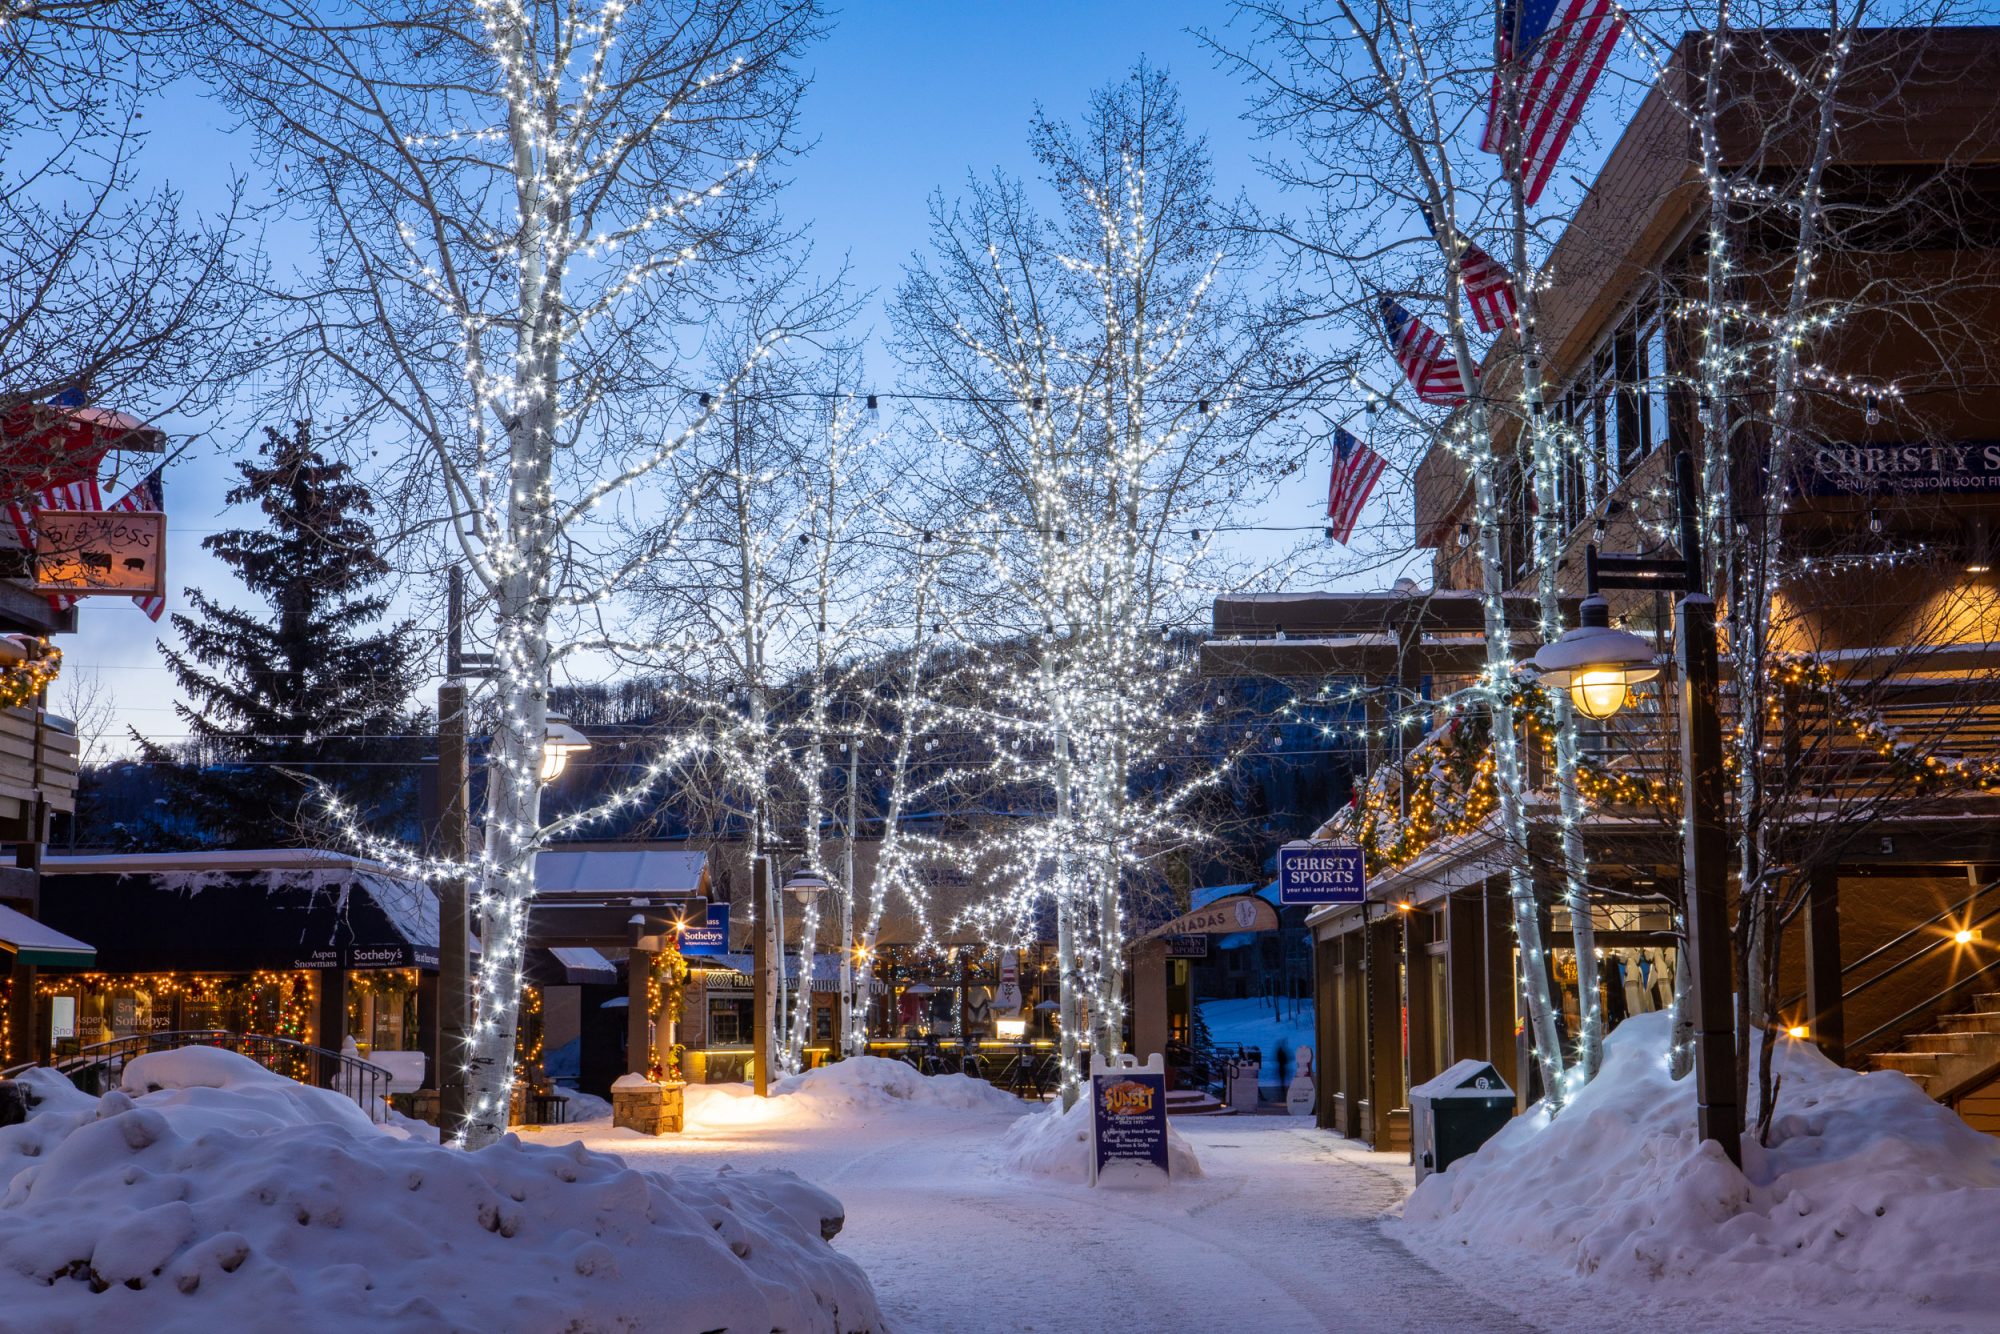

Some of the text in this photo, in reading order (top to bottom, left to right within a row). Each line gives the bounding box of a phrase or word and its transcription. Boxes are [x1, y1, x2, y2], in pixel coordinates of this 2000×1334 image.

[1814, 446, 1973, 473] CHRISTY
[1902, 476, 1950, 488] CUSTOM
[1953, 476, 1985, 487] BOOT
[1286, 857, 1357, 871] CHRISTY
[1291, 871, 1354, 884] SPORTS
[1326, 886, 1342, 894] patio
[684, 931, 723, 942] Sotheby's
[311, 950, 337, 960] Aspen
[353, 948, 403, 962] Sotheby's
[1174, 946, 1206, 954] SPORTS
[294, 959, 337, 968] Snowmass
[115, 1015, 170, 1029] Sotheby's
[1105, 1087, 1154, 1111] SUNSET
